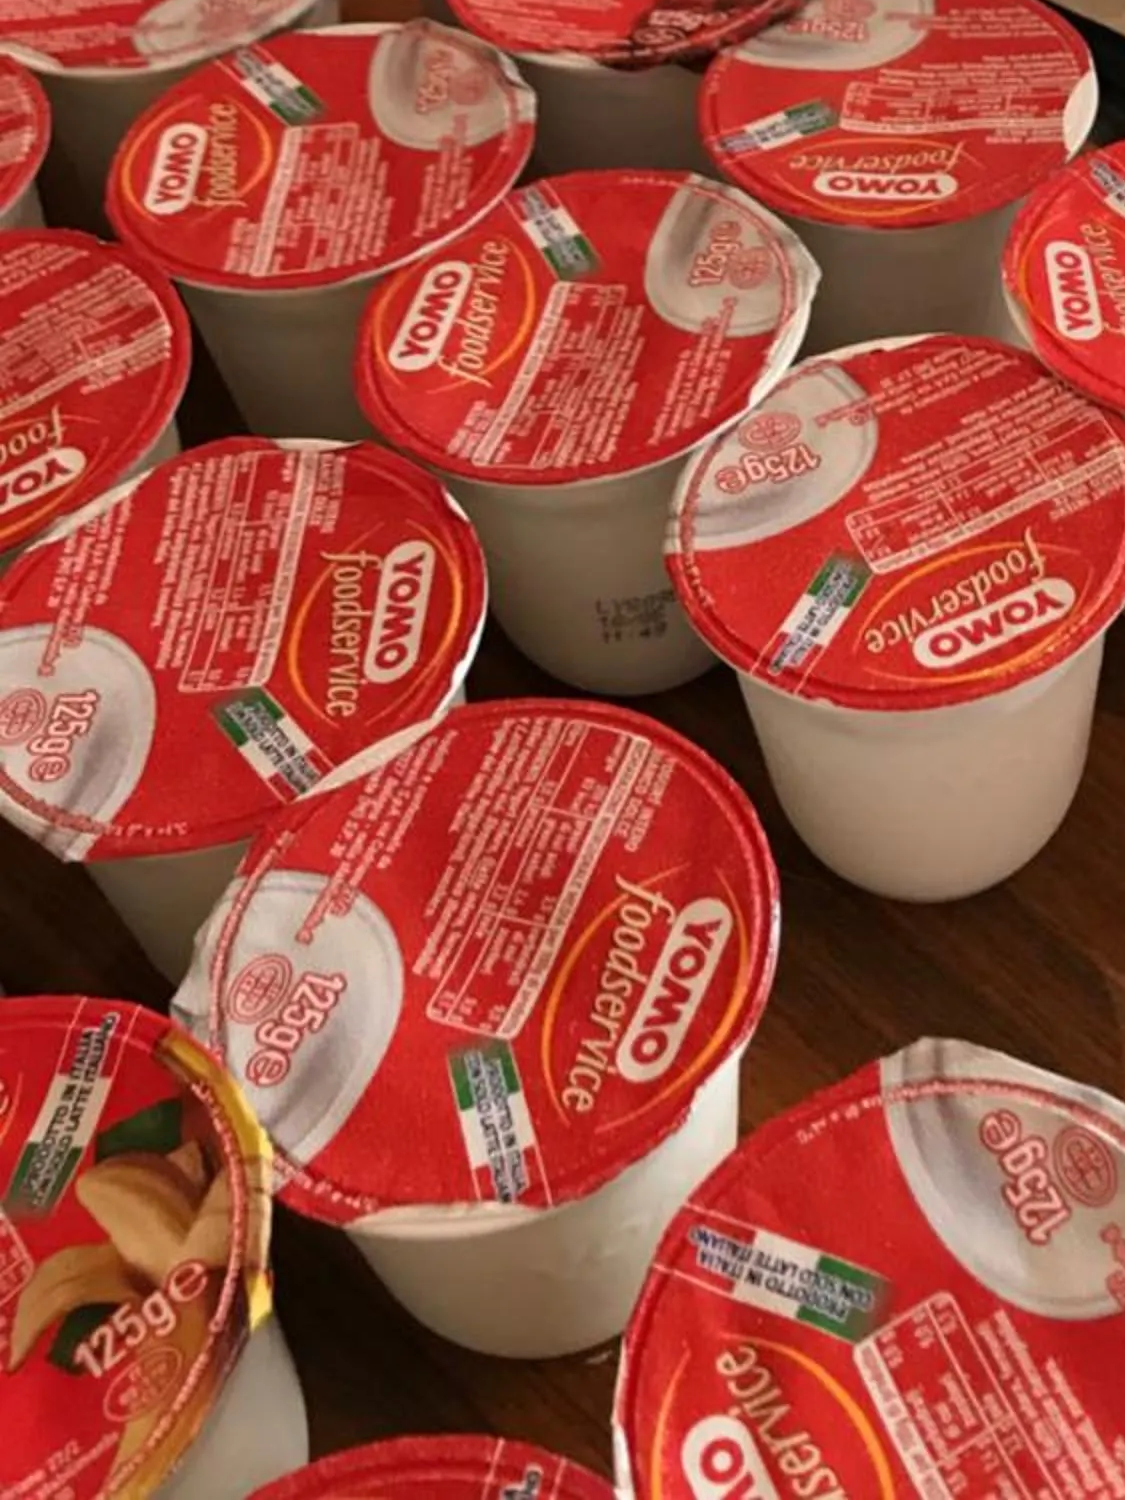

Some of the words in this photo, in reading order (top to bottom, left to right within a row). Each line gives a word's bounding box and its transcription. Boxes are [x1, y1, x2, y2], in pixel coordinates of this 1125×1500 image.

[156, 134, 198, 206] YOMO
[790, 141, 965, 174] foodservice
[828, 175, 943, 195] YOMO
[397, 268, 460, 360] YOMO
[437, 240, 509, 386] foodservice
[1055, 250, 1092, 330] YOMO
[320, 548, 382, 718] foodservice
[375, 550, 427, 669] YOMO
[866, 527, 1047, 652] foodservice
[929, 595, 1065, 658] YOMO
[562, 874, 676, 1113] foodservice
[629, 918, 722, 1066] YOMO
